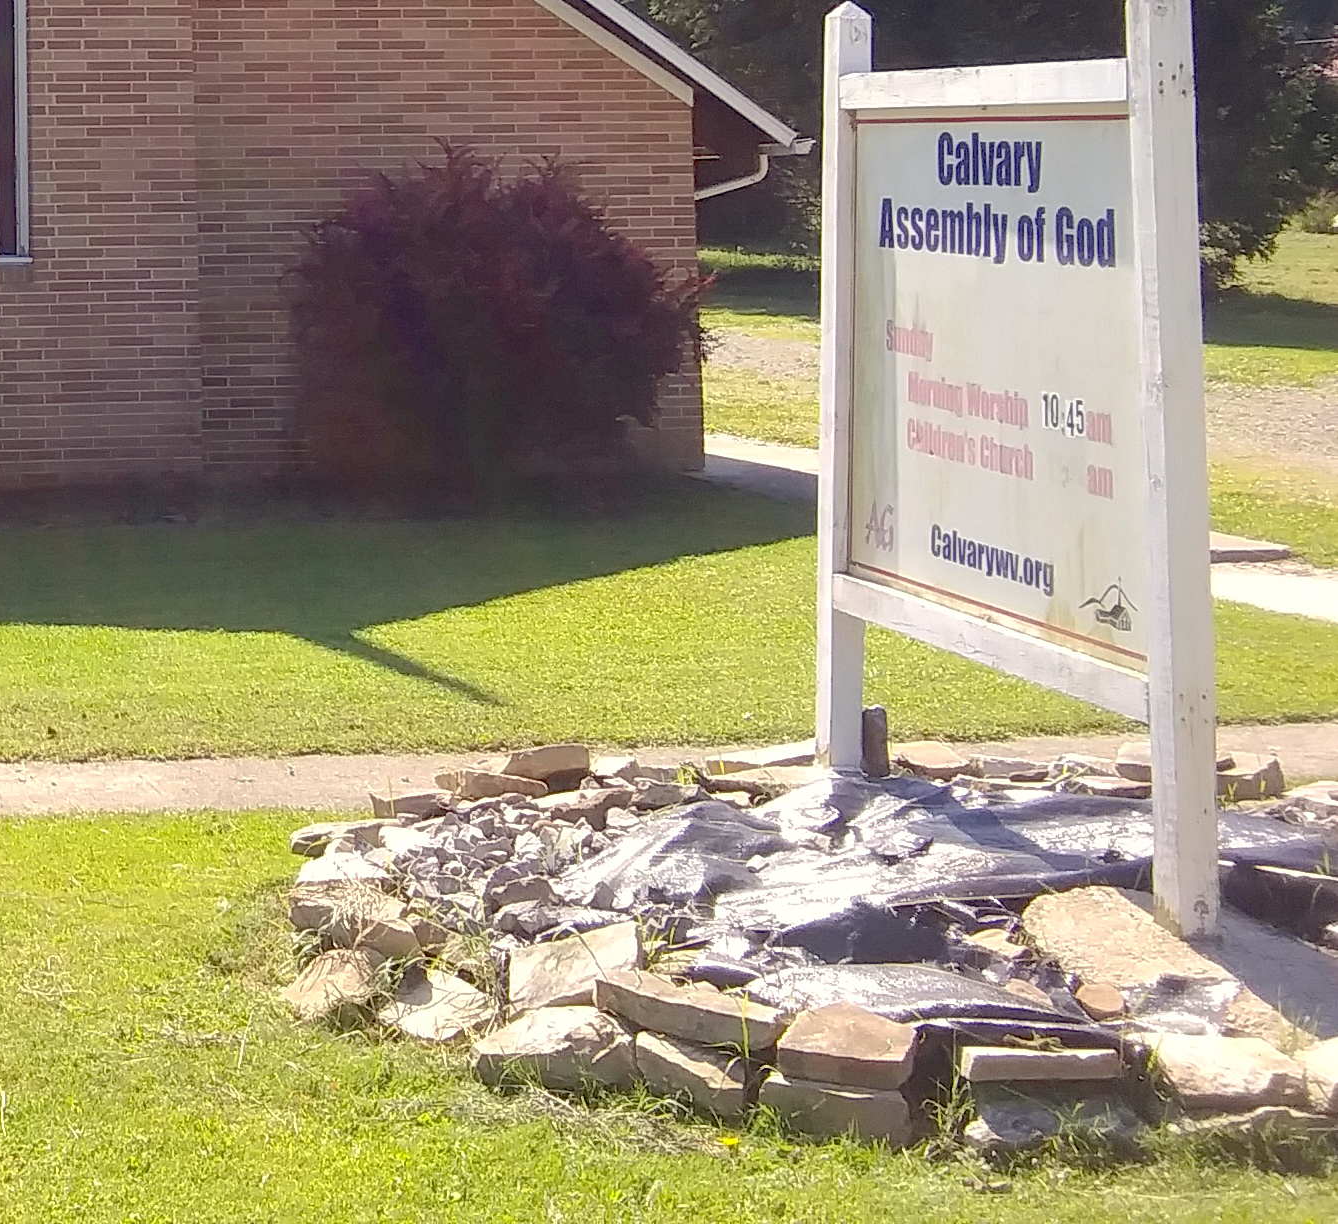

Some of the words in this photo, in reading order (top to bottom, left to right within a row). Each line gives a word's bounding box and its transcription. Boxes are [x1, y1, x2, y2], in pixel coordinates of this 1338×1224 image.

[938, 132, 1042, 193] Calvary
[879, 198, 1008, 264] Assembly
[1018, 207, 1046, 262] of
[1056, 207, 1116, 268] God
[908, 371, 963, 417] Morning
[967, 382, 1029, 430] Worship
[907, 418, 976, 465] Children's
[980, 435, 1034, 480] Church
[1087, 464, 1113, 499] am
[930, 524, 1054, 596] Calvarywv.org
